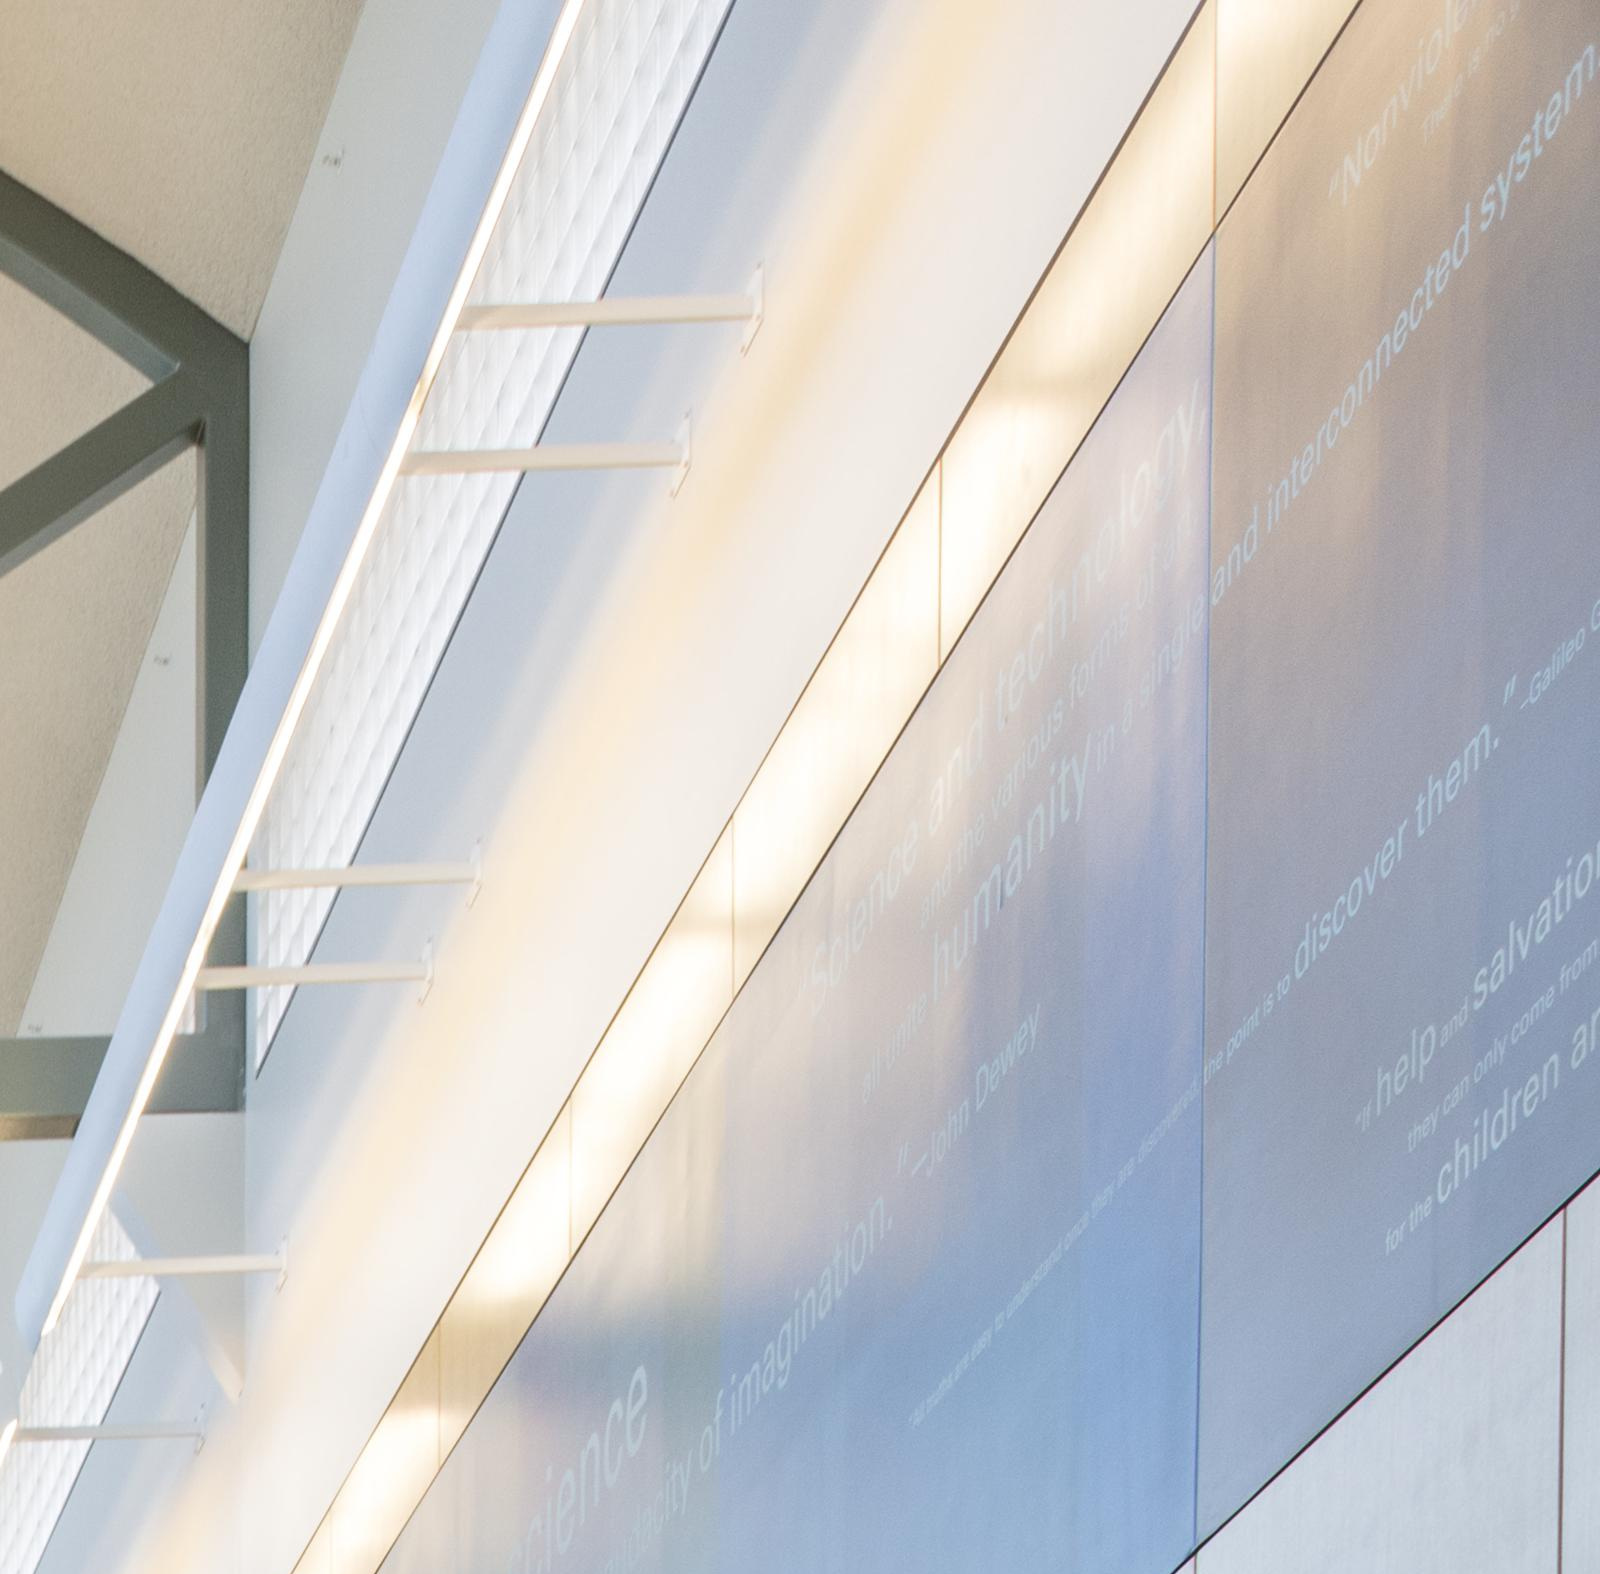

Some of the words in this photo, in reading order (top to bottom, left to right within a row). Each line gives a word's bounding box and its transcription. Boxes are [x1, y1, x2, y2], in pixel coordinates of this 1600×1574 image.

[933, 732, 1089, 1003] humanity
[1139, 590, 1205, 715] single
[1212, 503, 1258, 611] and
[1267, 200, 1470, 534] interconnected
[929, 688, 983, 841] and
[1226, 1002, 1260, 1066] point
[1294, 818, 1406, 983] discover
[1407, 1105, 1438, 1155] they
[1442, 1073, 1469, 1119] can
[1474, 1035, 1505, 1086] only
[1511, 983, 1555, 1047] come
[1559, 938, 1598, 997] from
[1377, 1018, 1436, 1116] help
[1440, 994, 1468, 1048] and
[1385, 1219, 1406, 1258] for
[1408, 1192, 1432, 1234] the
[1437, 1048, 1559, 1206] children
[699, 1387, 724, 1479] of
[976, 1002, 1040, 1114] Dewey
